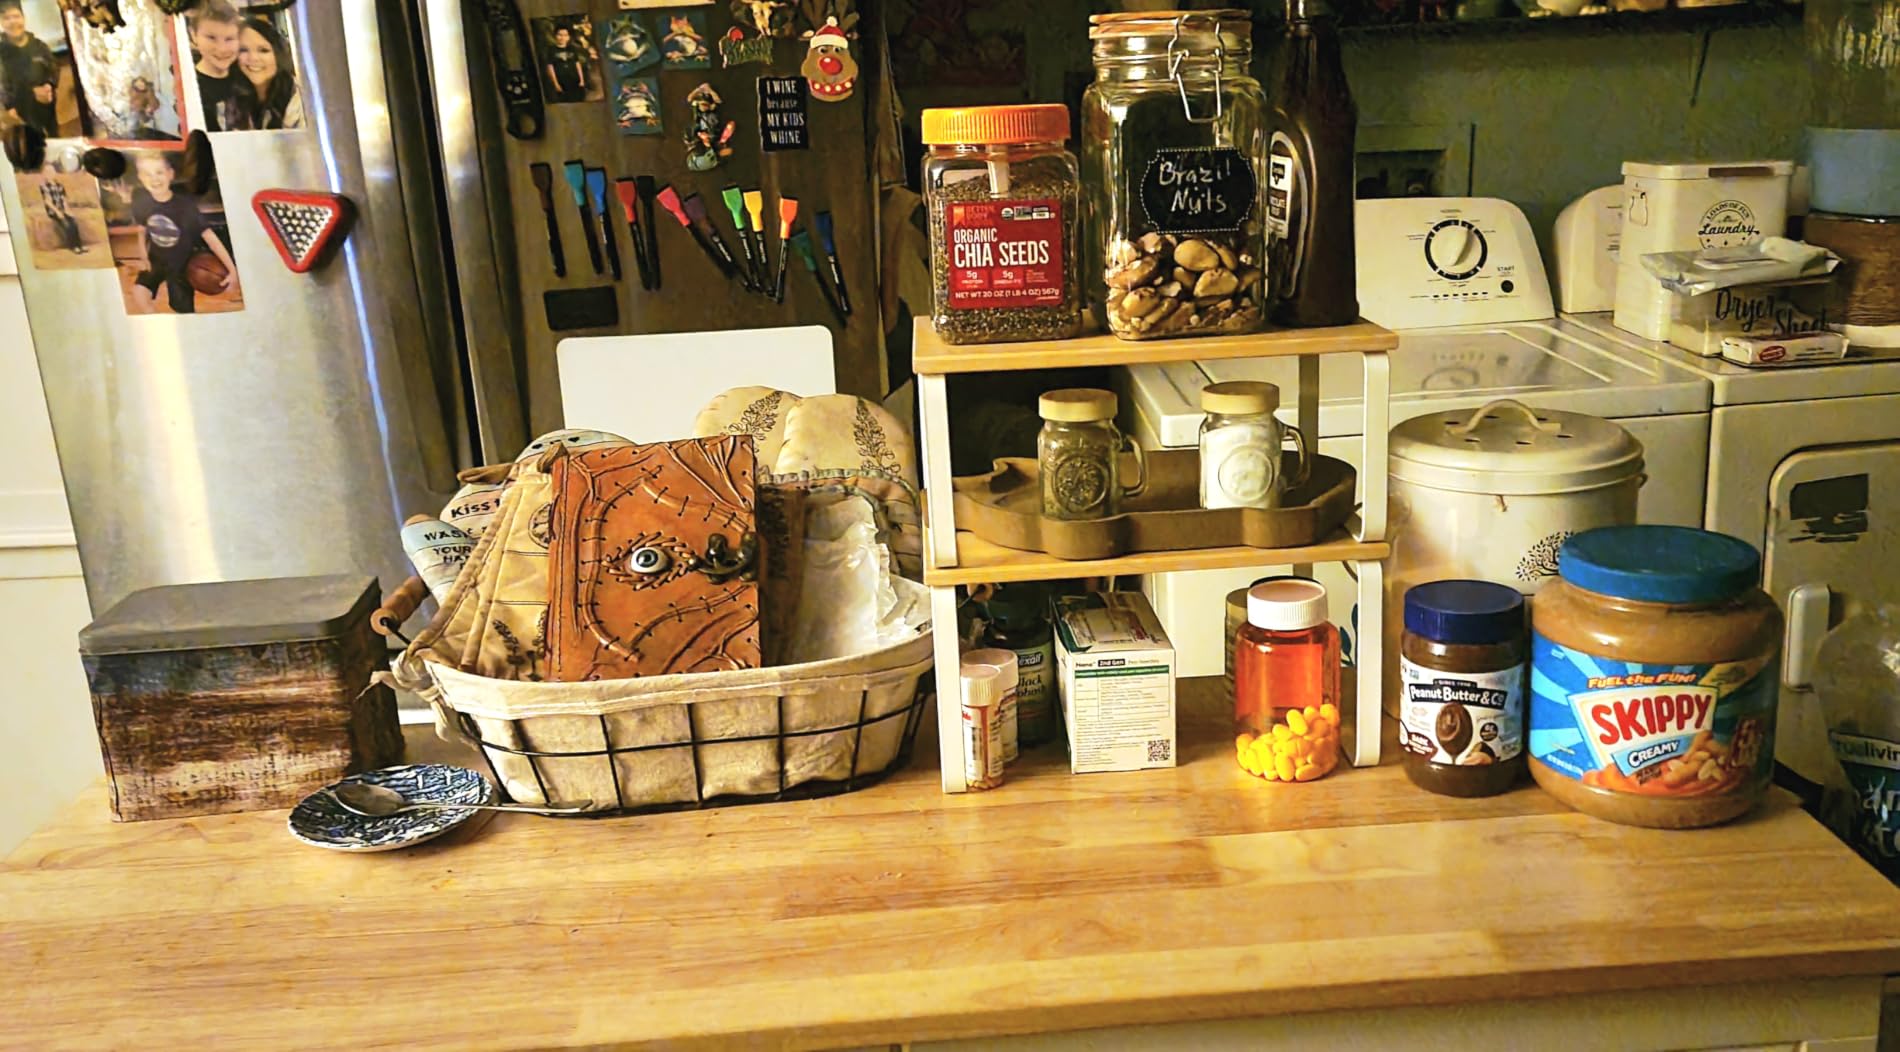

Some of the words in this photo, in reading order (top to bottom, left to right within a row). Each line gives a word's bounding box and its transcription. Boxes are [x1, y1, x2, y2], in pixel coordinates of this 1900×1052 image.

[766, 80, 771, 95] I
[772, 80, 797, 94] WINE
[766, 112, 780, 127] MY
[782, 112, 805, 126] KIDS
[770, 130, 801, 144] WHINE
[1159, 157, 1231, 186] Brazil
[953, 228, 998, 244] ORGANIC
[1698, 221, 1760, 236] Laundry
[954, 243, 994, 268] CHIA
[999, 240, 1050, 266] SEEDS
[966, 270, 978, 280] 5g
[1002, 270, 1014, 280] 5g
[1042, 287, 1060, 296] 567g
[1715, 288, 1775, 333] Dryer
[450, 501, 491, 518] Kiss
[433, 546, 472, 554] YOUR
[1018, 653, 1042, 667] exall
[1409, 685, 1443, 699] Peanut
[1443, 687, 1480, 701] Butter
[1480, 691, 1491, 704] &
[1591, 693, 1712, 745] SKIPPY
[1628, 740, 1680, 767] CREAMY
